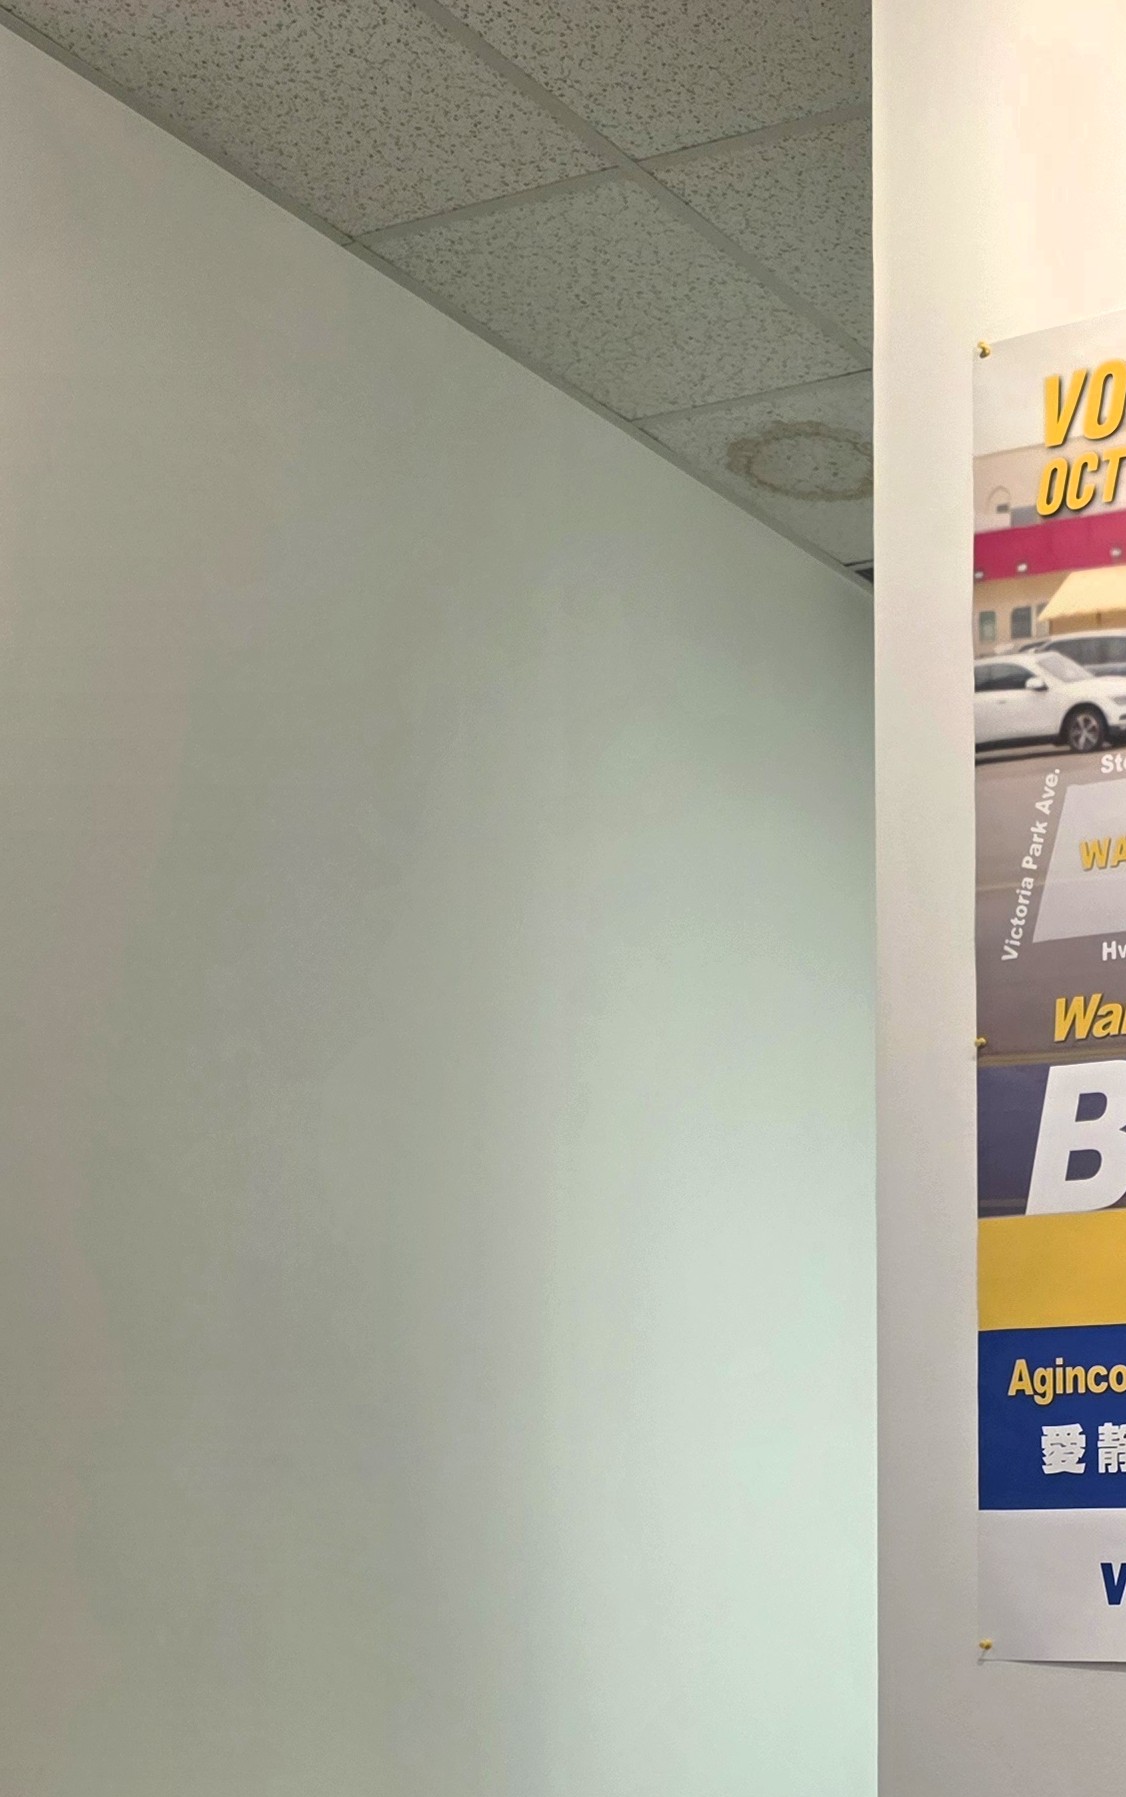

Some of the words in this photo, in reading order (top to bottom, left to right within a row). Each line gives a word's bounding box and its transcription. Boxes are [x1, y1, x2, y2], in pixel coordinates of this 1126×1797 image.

[1001, 873, 1034, 963] Victoria
[1022, 820, 1047, 871] Park
[1041, 768, 1061, 816] Ave.
